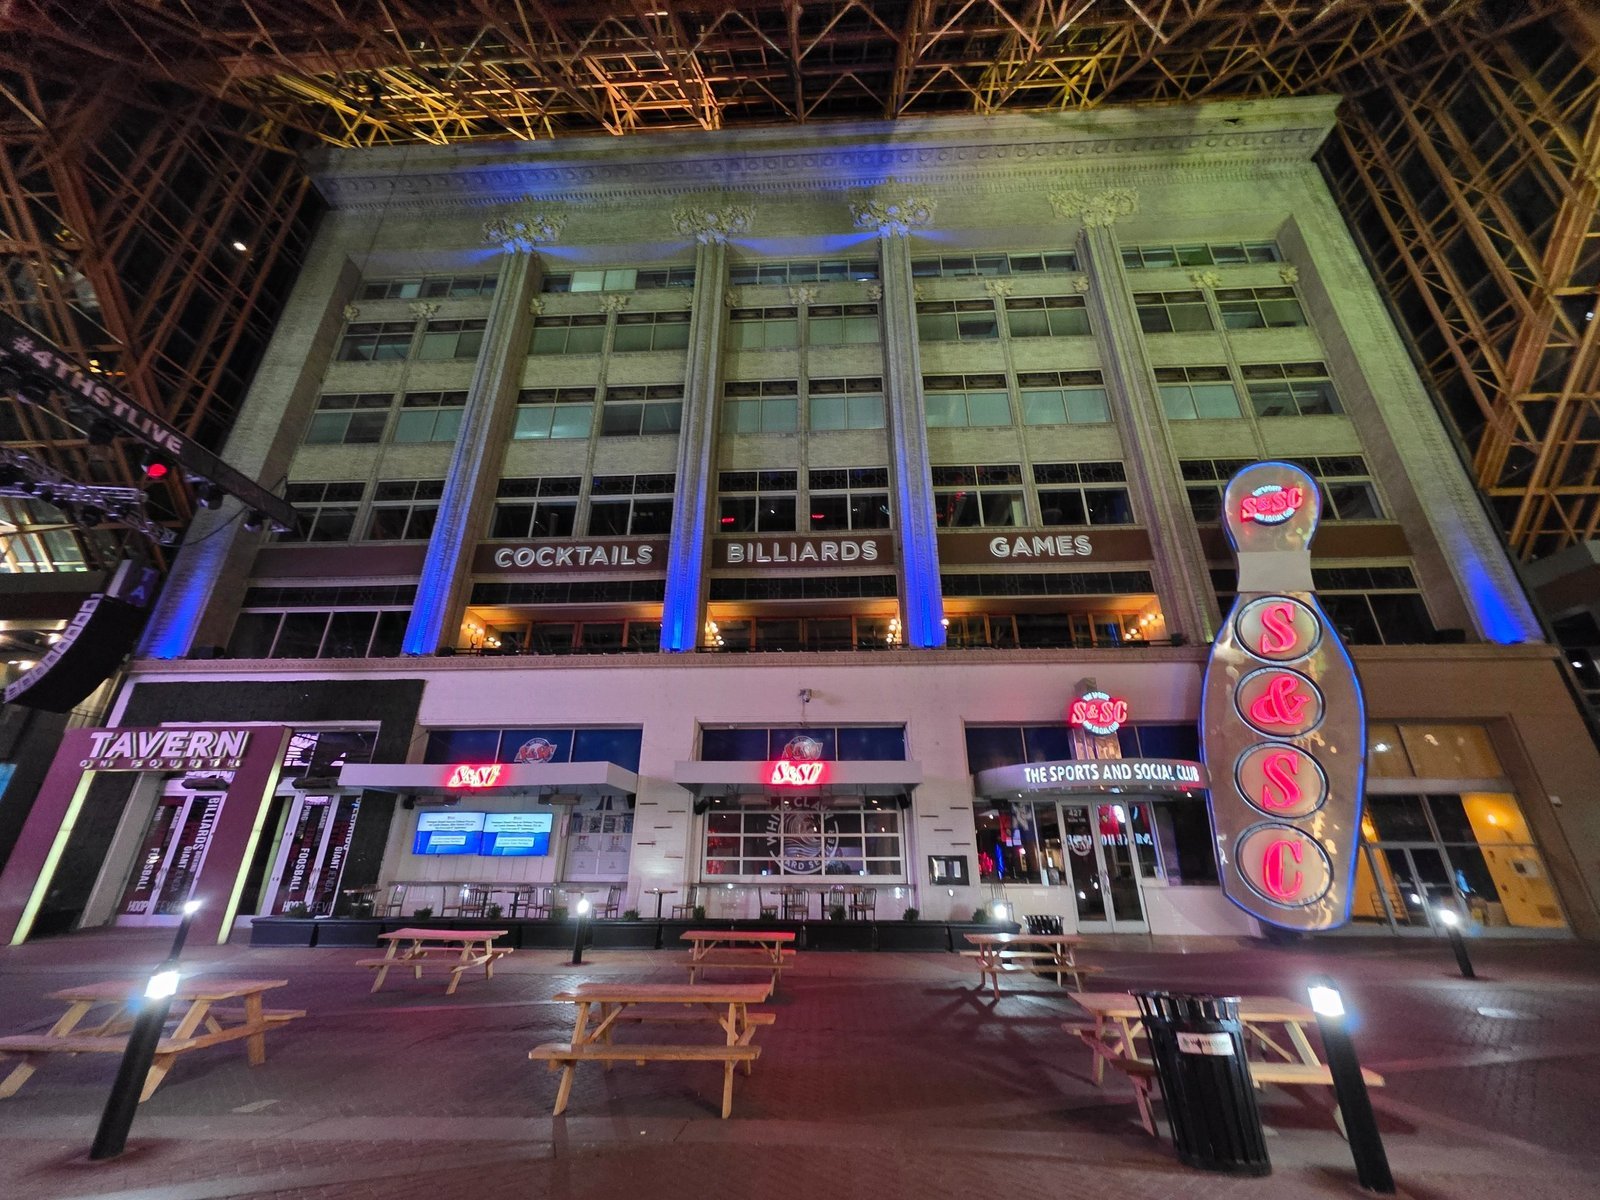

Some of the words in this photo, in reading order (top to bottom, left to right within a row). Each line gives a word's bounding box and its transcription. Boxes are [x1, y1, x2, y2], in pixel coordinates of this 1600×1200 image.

[12, 336, 183, 455] #4THSTLIVE
[1242, 487, 1303, 518] S&SC
[495, 545, 653, 567] COCKTAILS
[727, 540, 878, 563] BILLIARDS
[990, 535, 1093, 557] GAMES
[1072, 700, 1128, 723] S&SC
[89, 731, 248, 758] TAVERN
[79, 759, 112, 769] ON
[130, 758, 241, 769] FOURTH
[1024, 767, 1047, 783] THE
[1050, 764, 1100, 781] SPORTS
[1103, 764, 1132, 780] AND
[1135, 763, 1175, 781] SOCIAL
[1176, 765, 1200, 781] CLUB
[193, 797, 220, 851] BILLIARDS
[1068, 809, 1082, 817] 427
[178, 846, 193, 870] GIANT
[330, 846, 343, 870] GIANT
[289, 847, 310, 893] FOOSBALL
